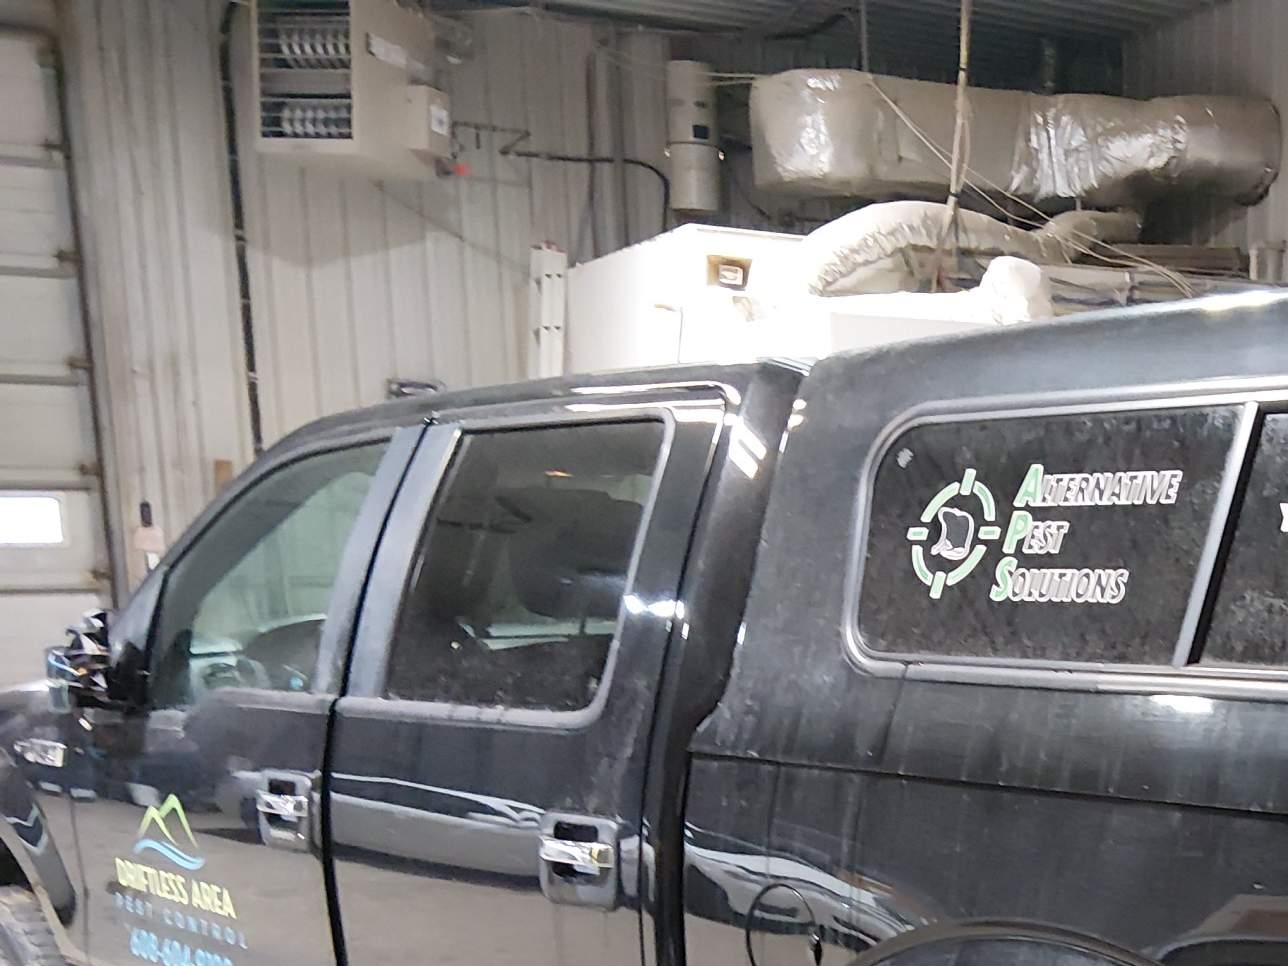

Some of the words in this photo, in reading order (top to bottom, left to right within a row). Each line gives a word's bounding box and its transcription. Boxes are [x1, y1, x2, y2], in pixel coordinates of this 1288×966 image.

[1013, 464, 1183, 507] ALTERNATIVE
[1002, 510, 1070, 554] PEST
[990, 556, 1129, 604] SOLUTIONS
[191, 879, 238, 920] AREA
